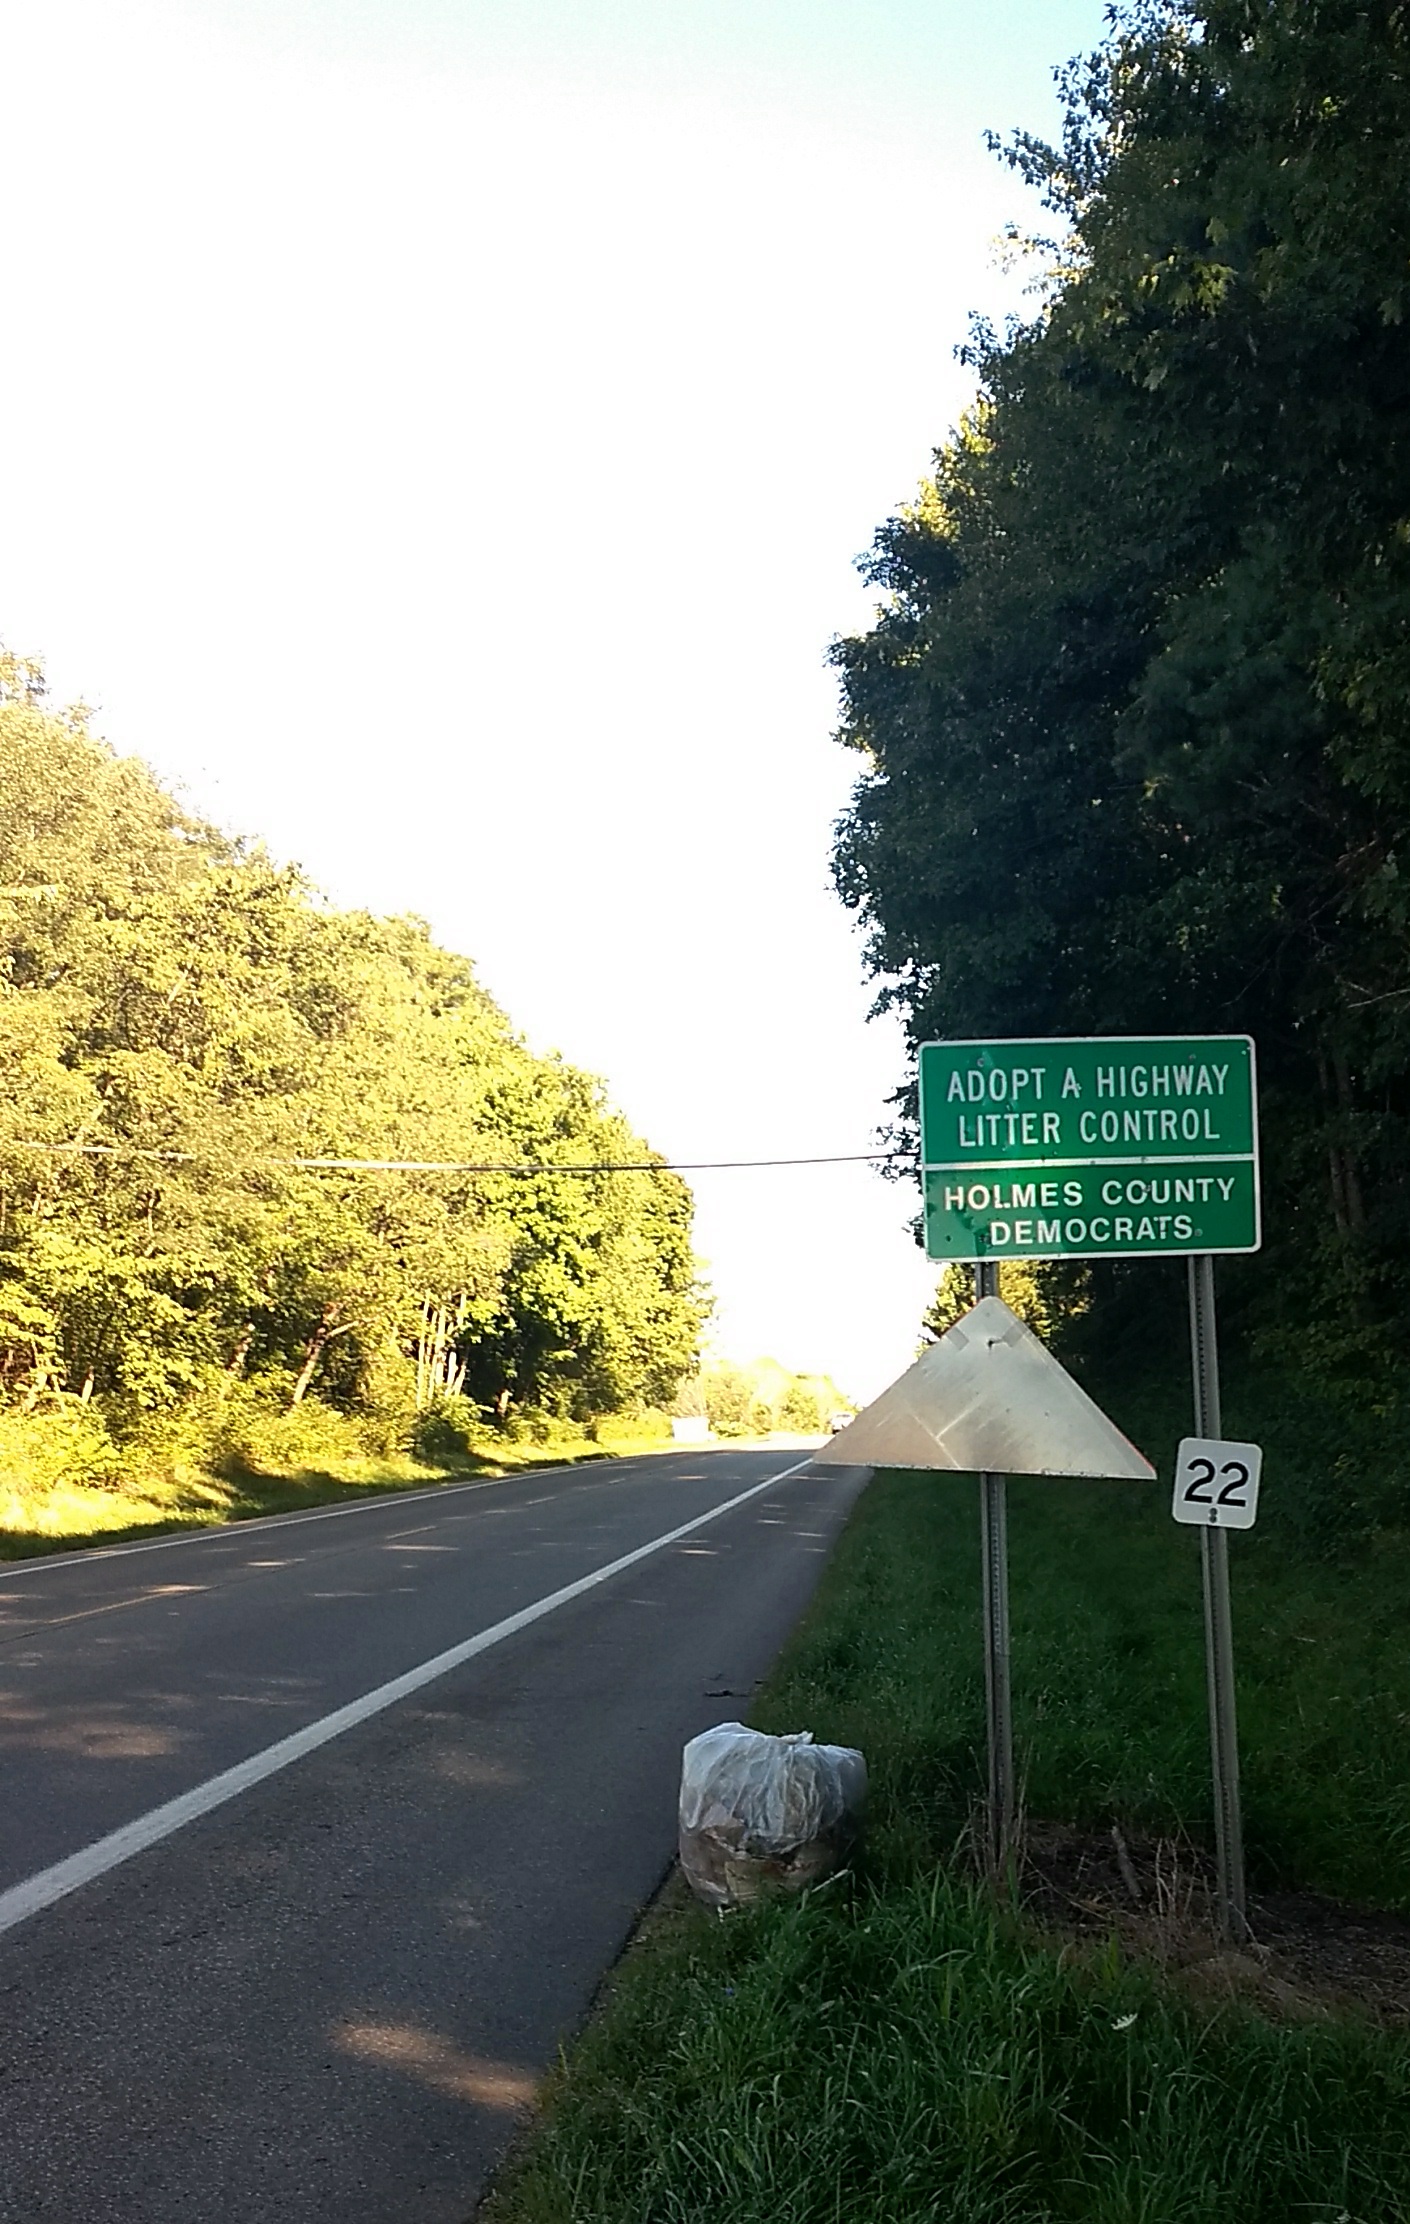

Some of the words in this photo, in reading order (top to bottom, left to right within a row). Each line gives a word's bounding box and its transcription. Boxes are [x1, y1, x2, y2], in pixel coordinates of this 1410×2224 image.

[947, 1068, 1046, 1102] ADOPT
[1061, 1067, 1081, 1099] A
[1097, 1064, 1229, 1097] HIGHWAY
[959, 1112, 1061, 1147] LITTER
[1080, 1108, 1221, 1143] CONTROL
[944, 1181, 1083, 1211] HOLMES
[1102, 1177, 1235, 1206] COUNTY
[990, 1214, 1193, 1246] DEMOCRATS
[1184, 1458, 1249, 1508] 22
